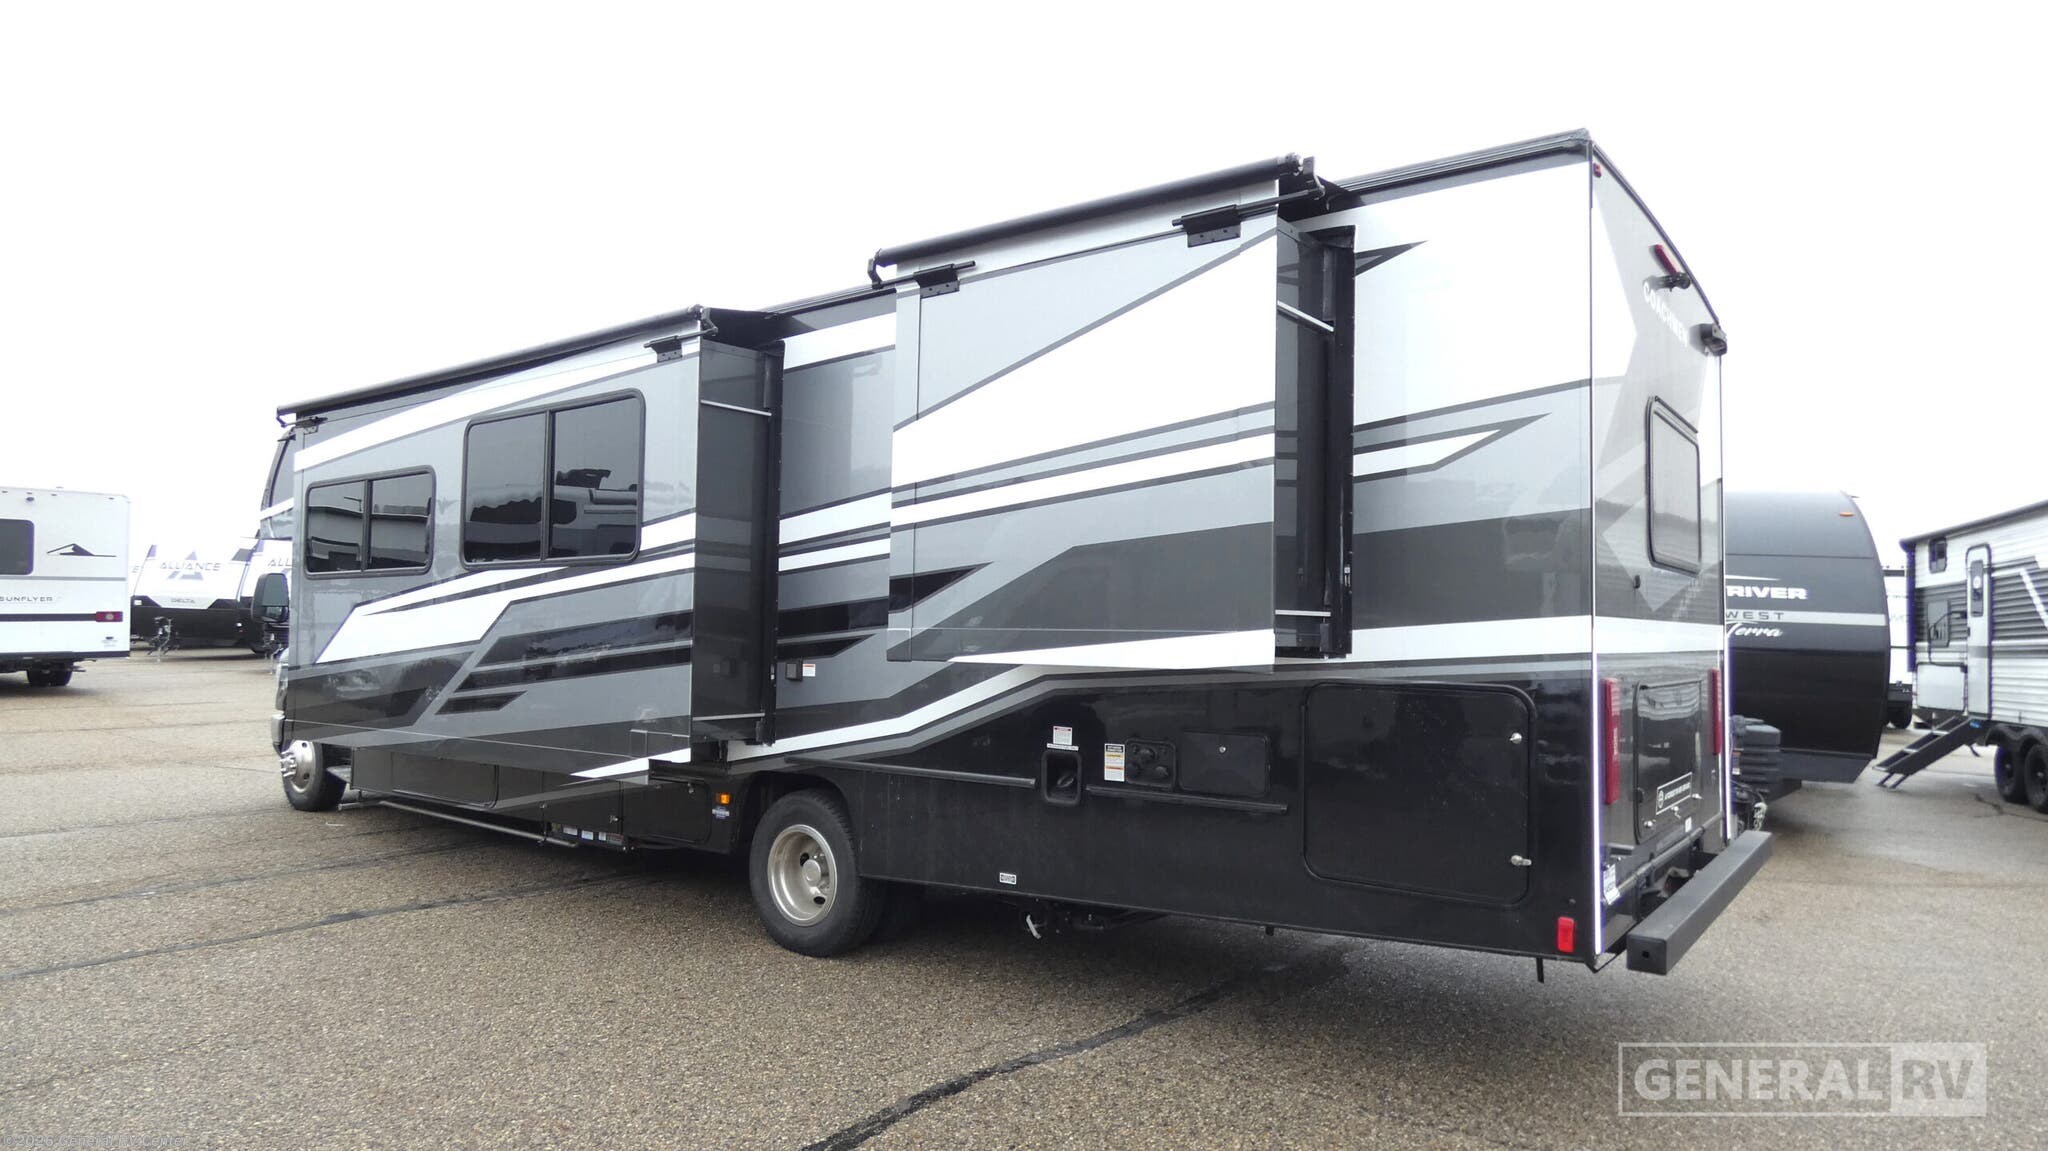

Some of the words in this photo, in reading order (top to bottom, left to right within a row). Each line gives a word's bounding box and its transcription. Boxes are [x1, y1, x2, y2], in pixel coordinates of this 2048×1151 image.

[160, 562, 221, 572] ALLIANCE
[1726, 585, 1808, 600] RIVER
[1726, 612, 1784, 621] WEST
[1726, 621, 1783, 638] Terra
